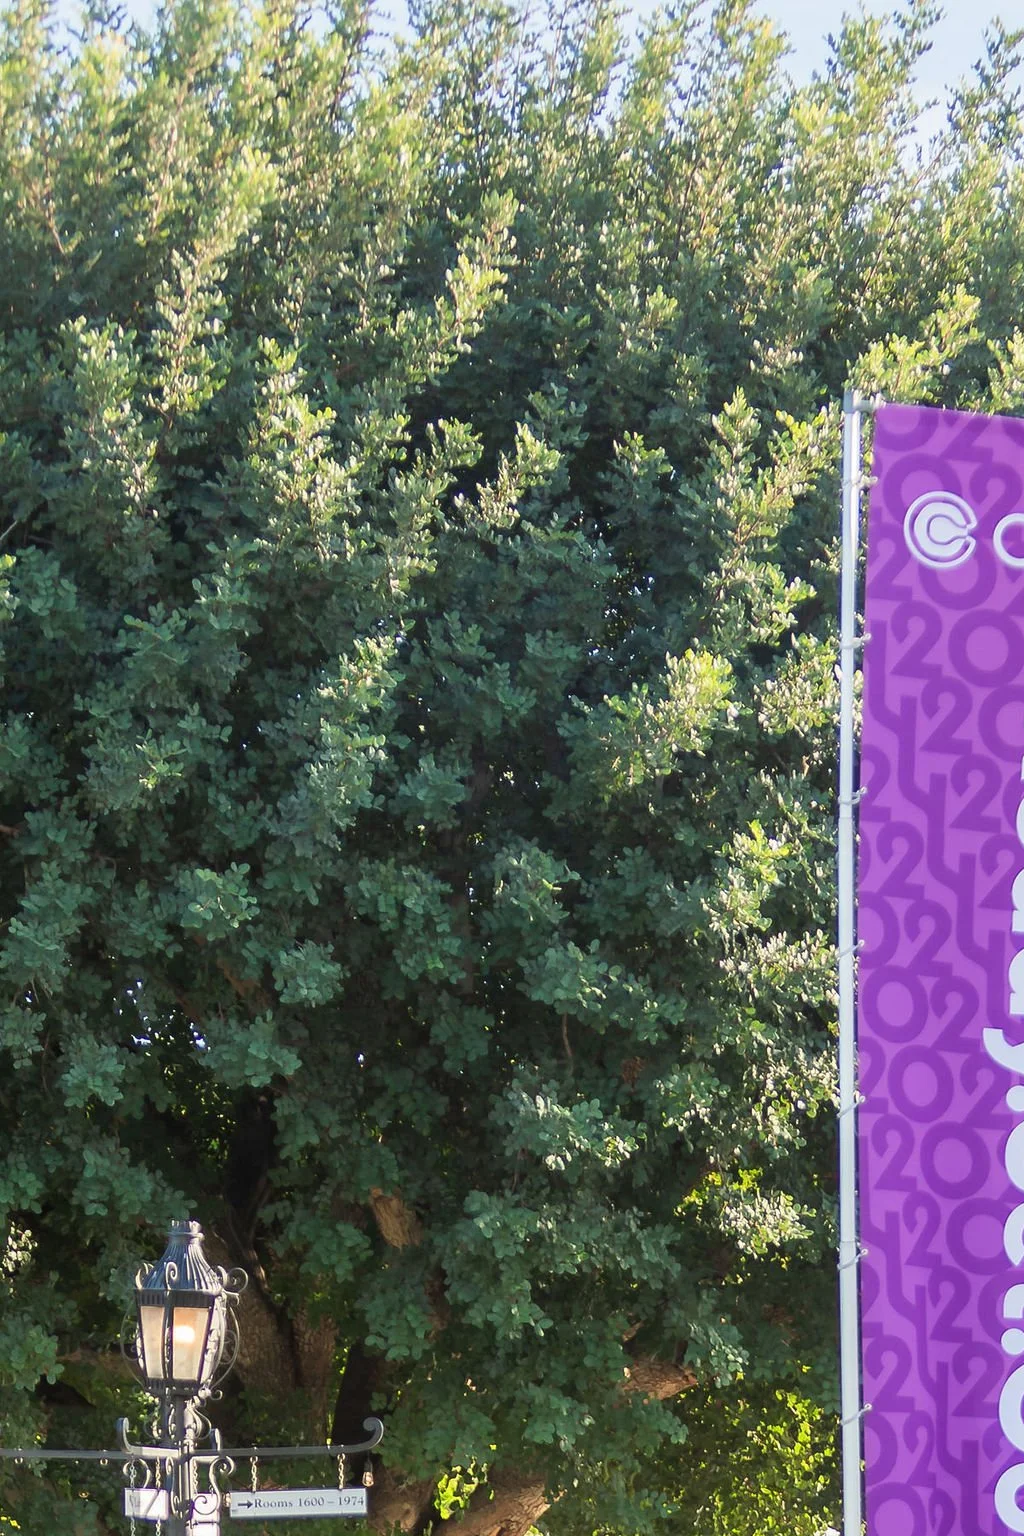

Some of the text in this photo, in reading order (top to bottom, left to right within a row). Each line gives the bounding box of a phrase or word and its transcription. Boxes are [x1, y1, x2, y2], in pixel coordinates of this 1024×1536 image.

[254, 1499, 293, 1509] Rooms
[299, 1497, 325, 1507] 1600
[339, 1496, 364, 1506] 1974
